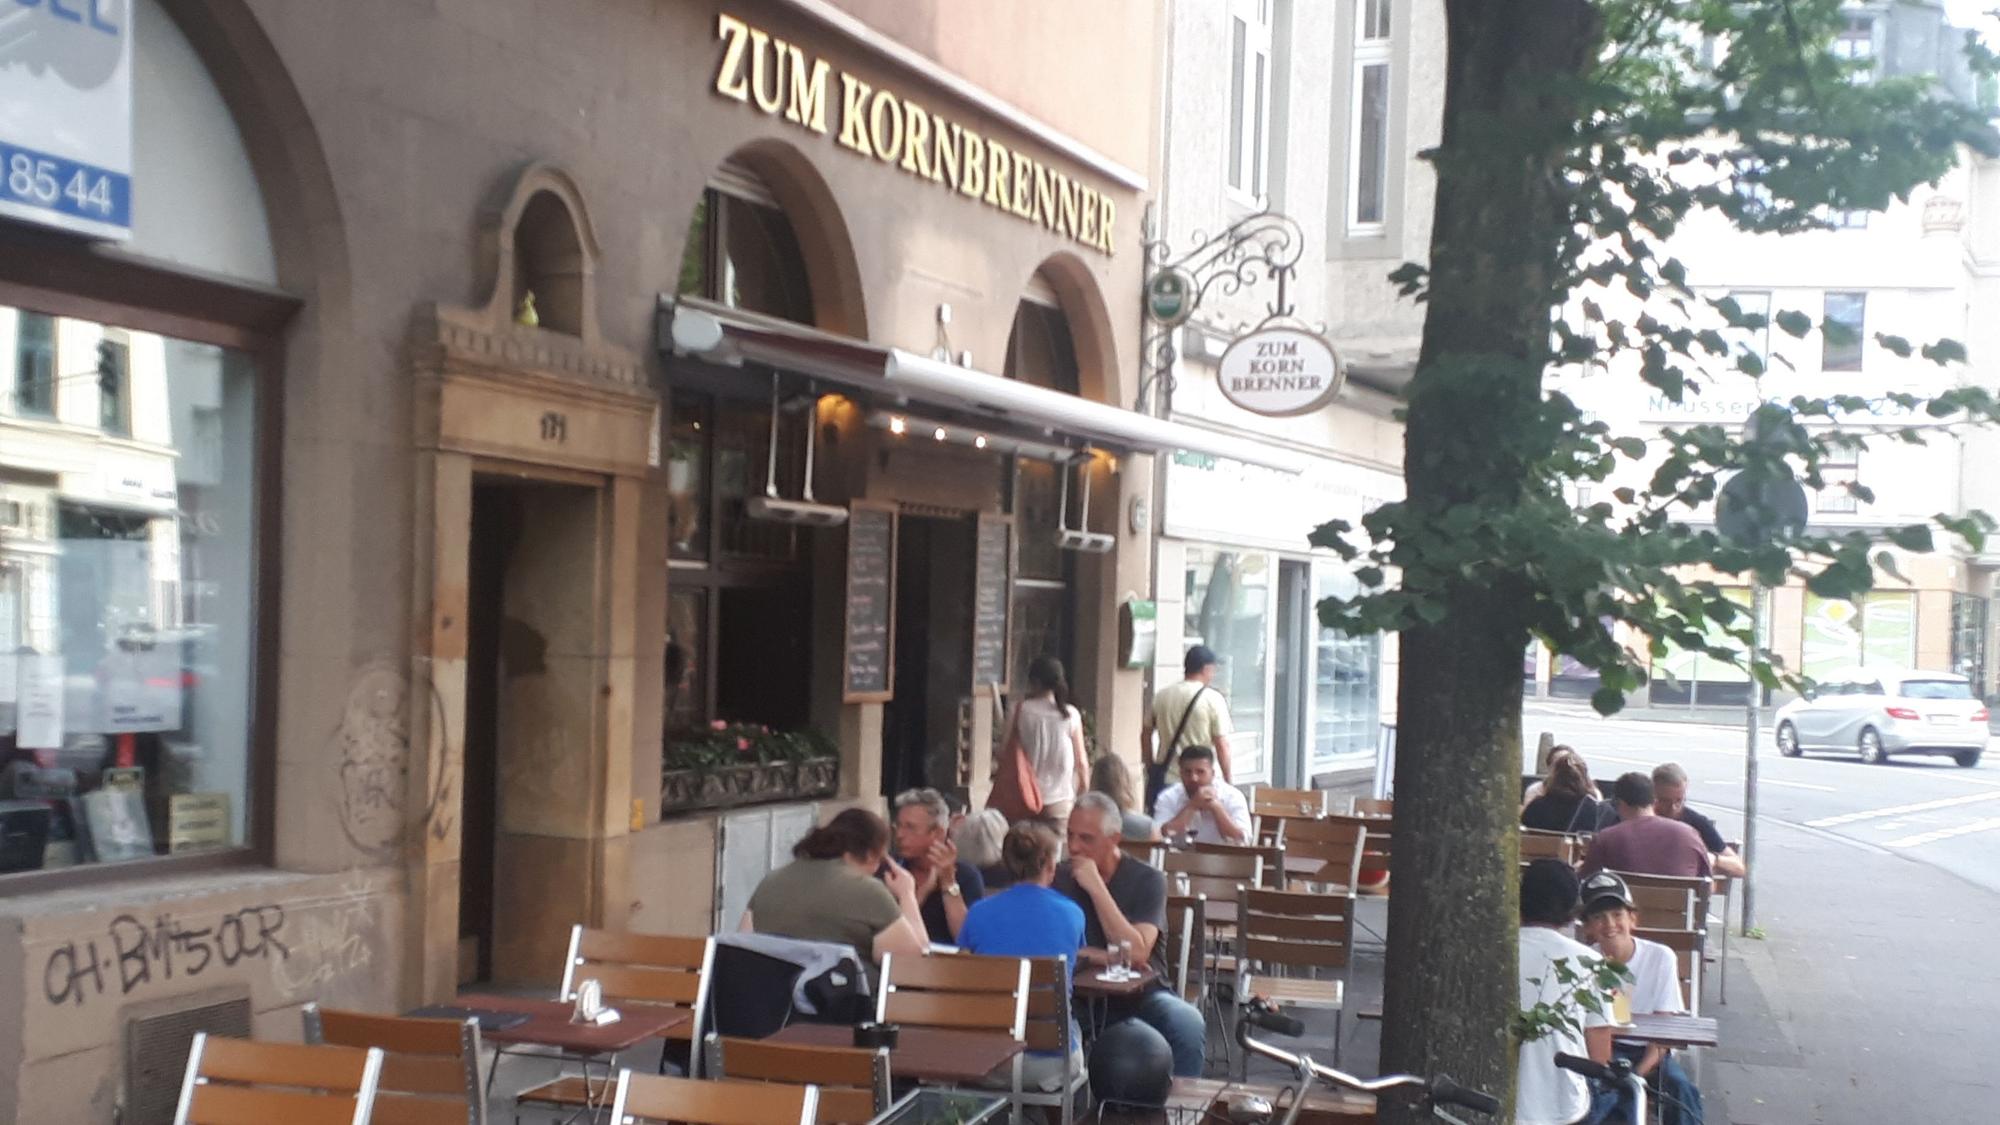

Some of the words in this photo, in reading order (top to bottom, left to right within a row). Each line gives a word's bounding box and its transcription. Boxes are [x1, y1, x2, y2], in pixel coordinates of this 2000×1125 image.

[717, 13, 831, 134] ZUM
[837, 72, 1117, 255] KORNBRENNER
[1256, 341, 1299, 357] ZUM
[1249, 359, 1305, 374] KORN
[1231, 375, 1322, 392] BRENNER
